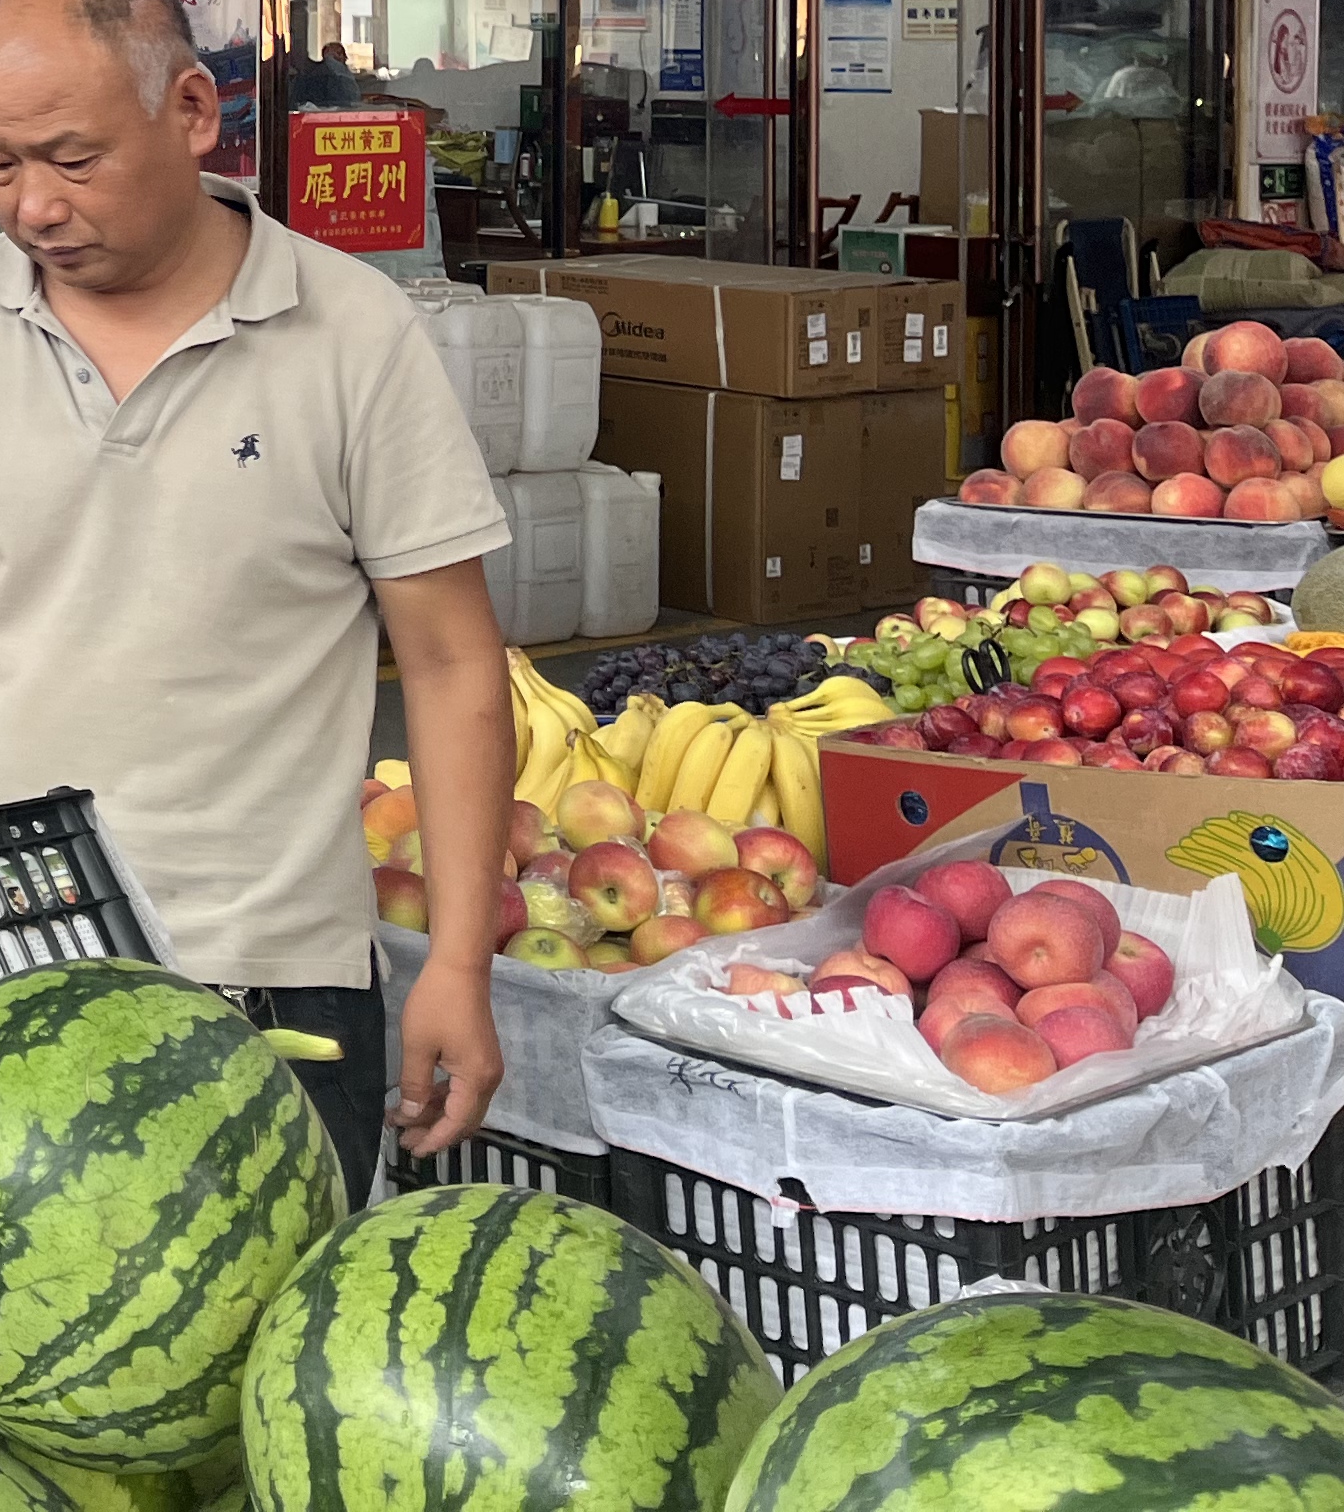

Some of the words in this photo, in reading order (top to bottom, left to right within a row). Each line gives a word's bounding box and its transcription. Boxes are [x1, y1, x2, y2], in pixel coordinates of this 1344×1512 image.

[321, 129, 394, 152] 代州黄酒
[300, 160, 407, 209] 雁門州
[601, 311, 666, 341] Midea
